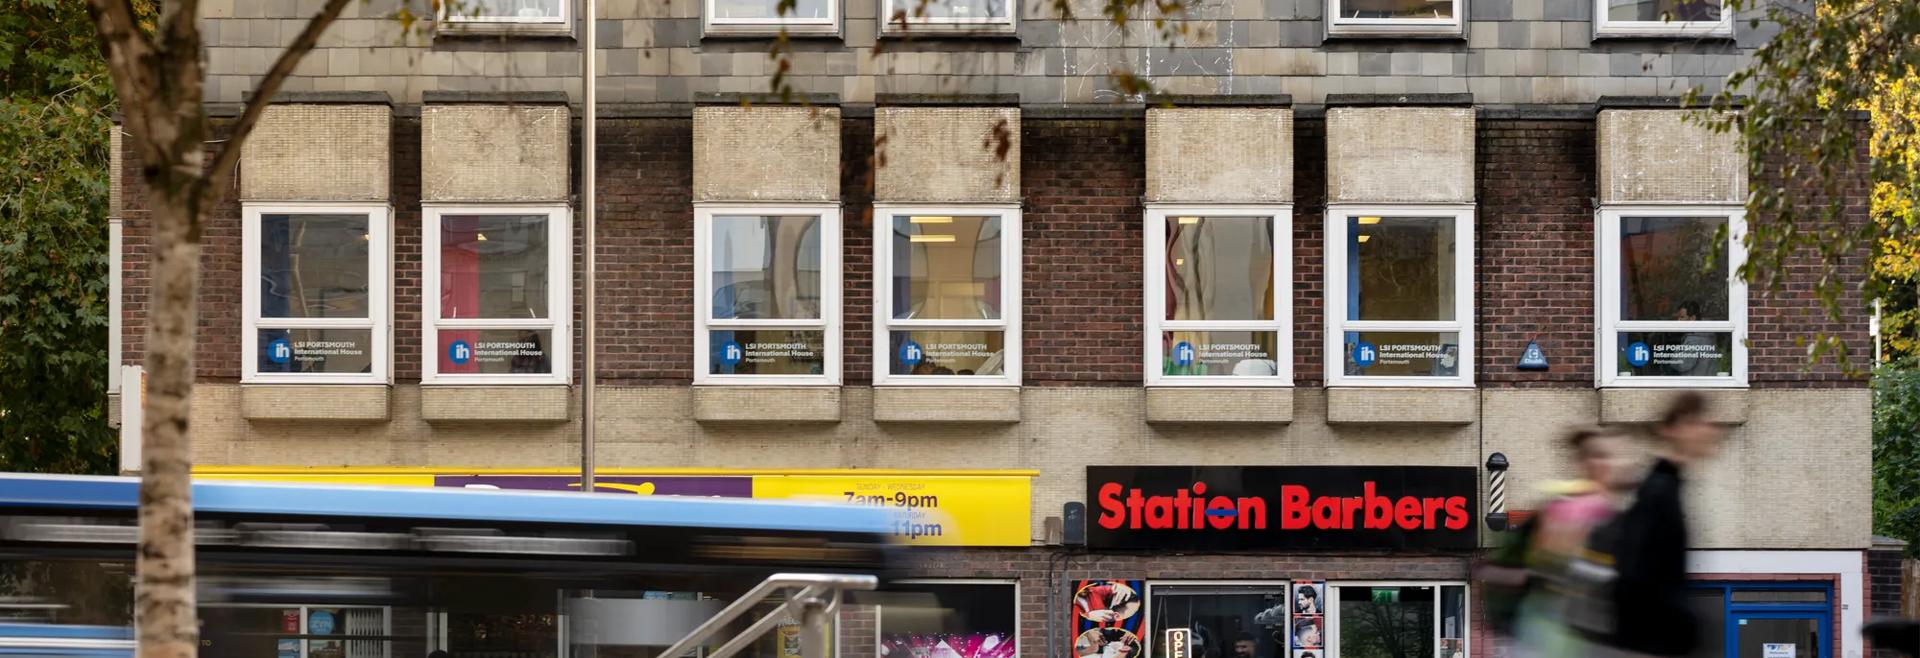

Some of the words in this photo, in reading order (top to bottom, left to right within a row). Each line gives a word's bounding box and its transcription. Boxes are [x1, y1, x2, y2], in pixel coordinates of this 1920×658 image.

[275, 343, 290, 358] ih
[456, 344, 470, 359] ih
[727, 345, 741, 359] ih
[907, 345, 921, 359] ih
[1180, 345, 1194, 360] ih
[1361, 346, 1375, 361] ih
[1635, 346, 1649, 361] ih
[844, 491, 938, 511] 7am-9pm
[1098, 482, 1266, 530] Station
[1281, 481, 1469, 530] Barbers
